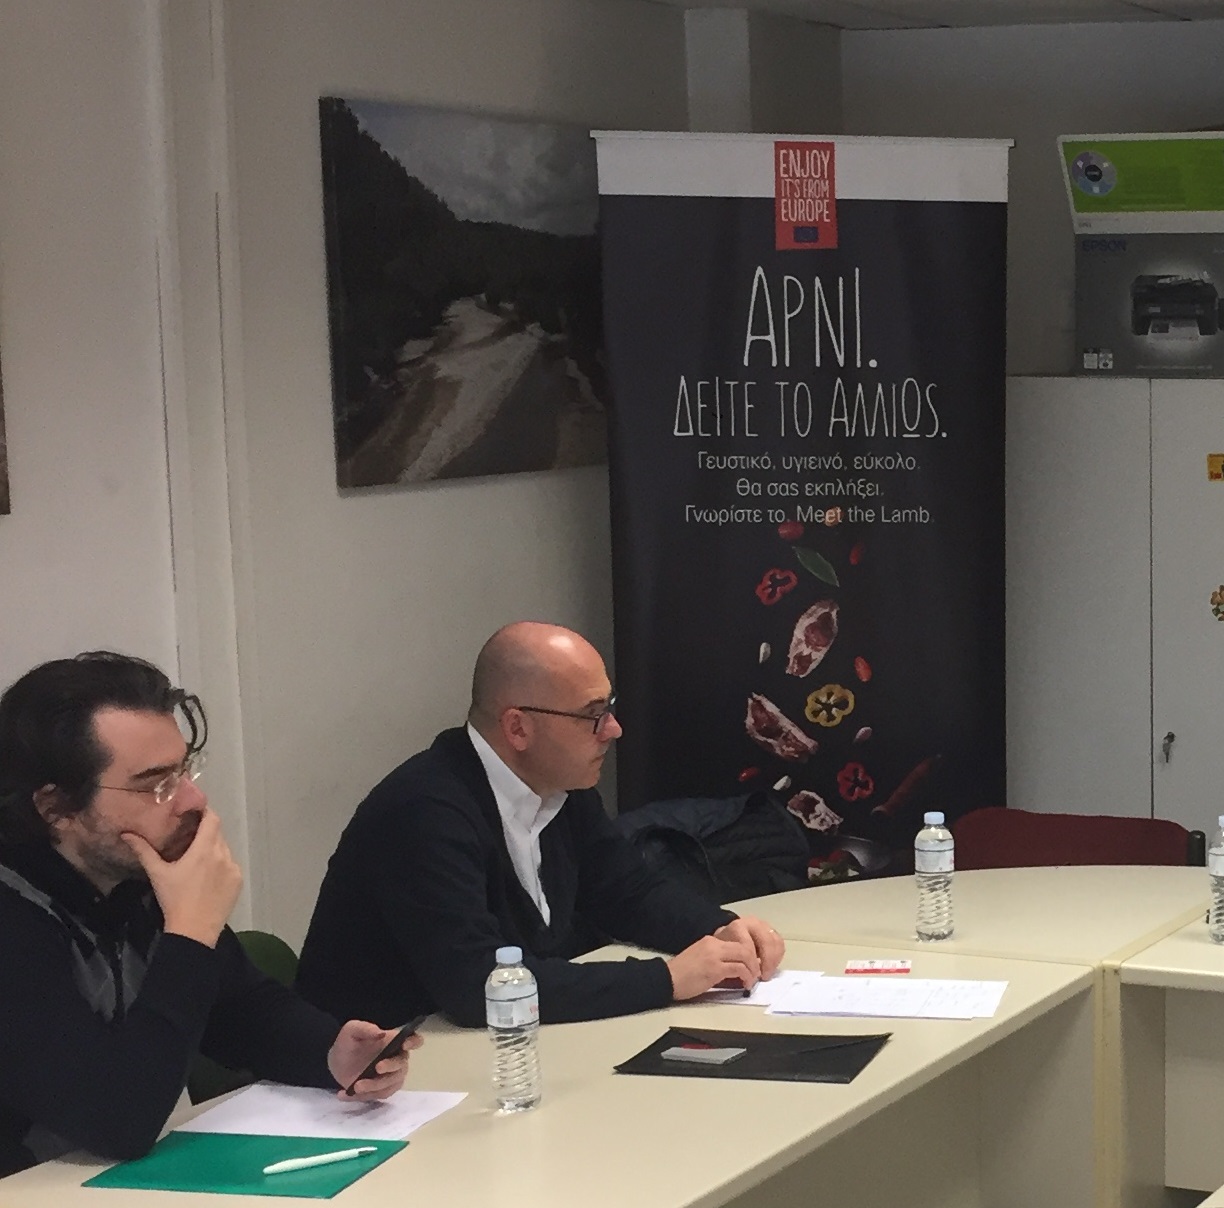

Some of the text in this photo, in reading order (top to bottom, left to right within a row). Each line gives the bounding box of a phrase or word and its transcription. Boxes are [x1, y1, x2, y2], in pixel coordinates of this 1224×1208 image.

[780, 149, 830, 178] ENJOY
[781, 179, 830, 199] IT'S FROM
[781, 199, 831, 222] EUROPE
[775, 381, 812, 438] ΤΟ
[736, 478, 762, 497] Θα
[767, 482, 800, 497] σας
[685, 505, 763, 526] Γνωρίστε
[796, 505, 842, 523] Meet
[848, 505, 875, 523] the
